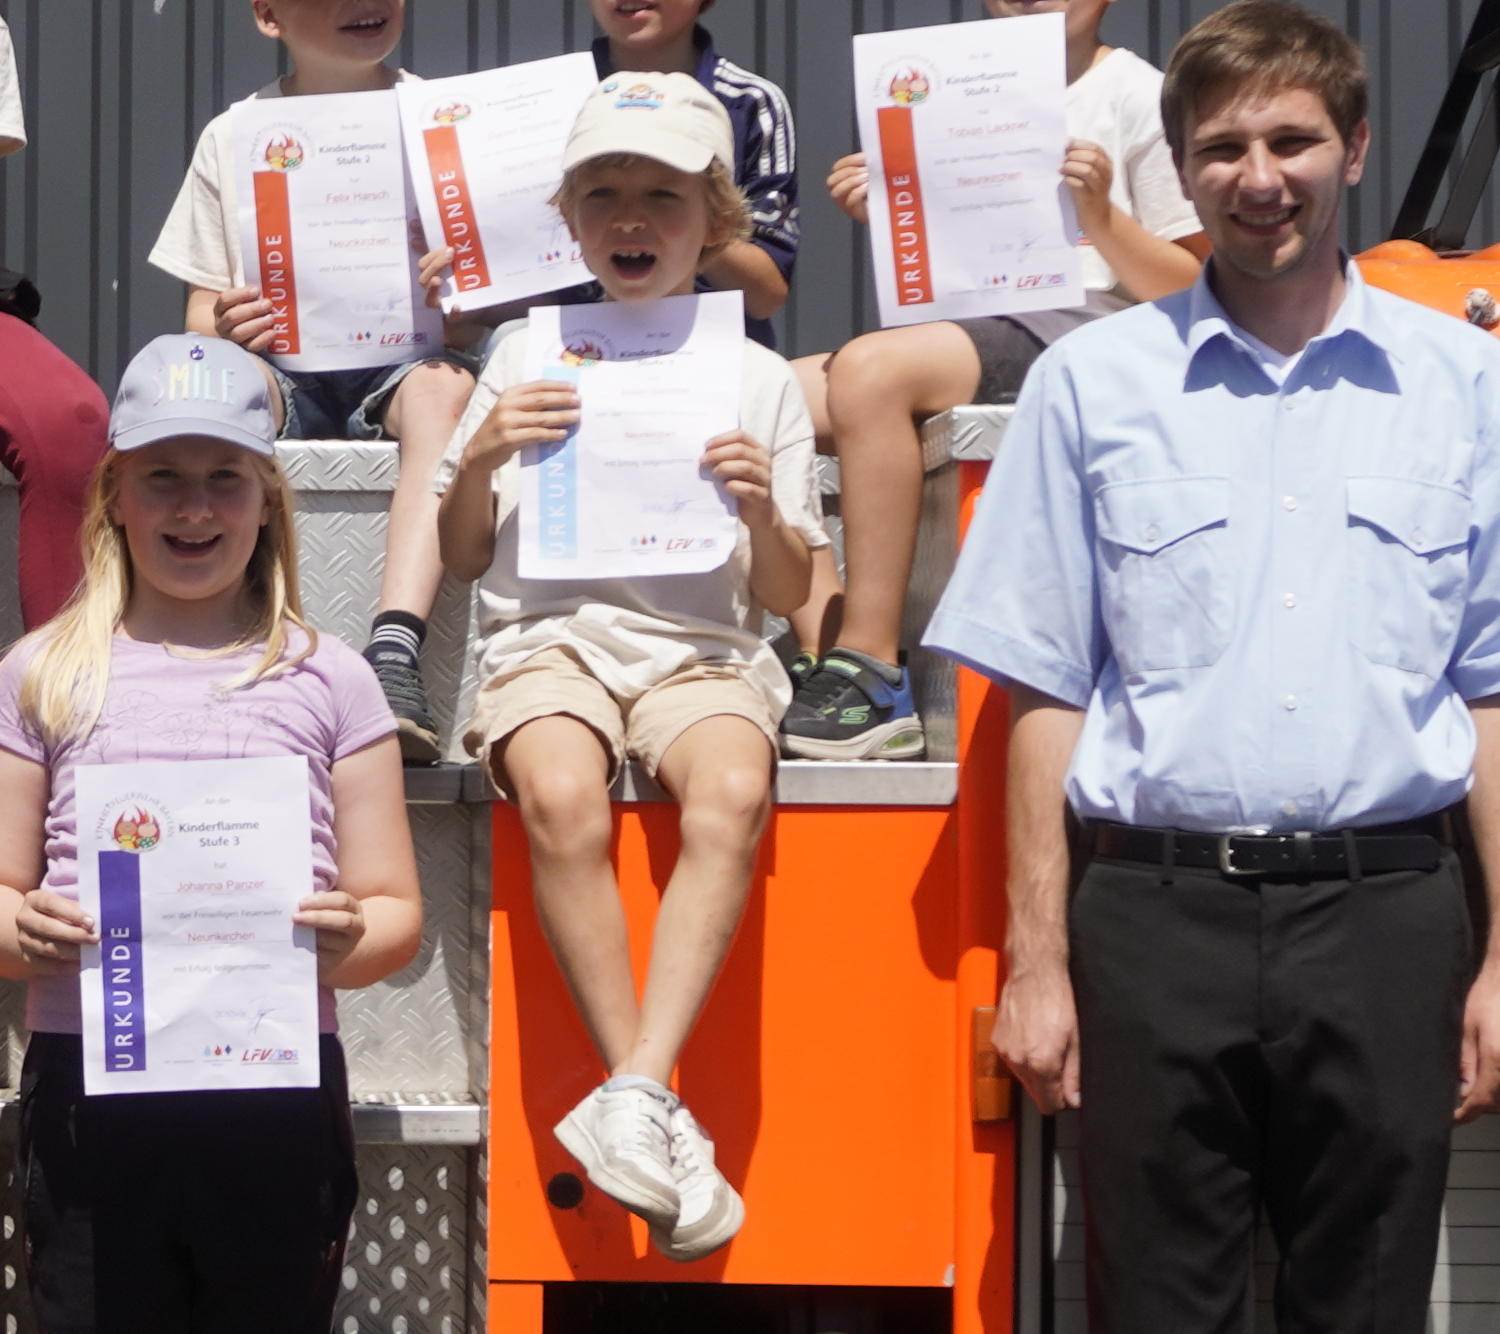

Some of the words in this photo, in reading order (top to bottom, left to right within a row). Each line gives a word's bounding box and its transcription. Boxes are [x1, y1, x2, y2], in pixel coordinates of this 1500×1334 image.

[319, 143, 387, 154] Kinderflamme
[336, 156, 361, 165] Stufe
[365, 155, 371, 163] 2
[326, 192, 350, 203] Felix
[439, 169, 479, 289] URKUNDE
[329, 236, 391, 248] Neunkirchen
[892, 173, 924, 302] URKUNDE
[265, 234, 291, 353] URKUNDE
[152, 363, 235, 405] SMILE
[179, 821, 260, 833] Kinderflamme
[199, 836, 230, 847] Stufe
[233, 836, 240, 846] 3
[176, 881, 223, 893] Johanna
[226, 879, 266, 891] Panzer
[187, 931, 256, 943] Neunkirchen
[110, 926, 134, 1069] URKUNDE
[241, 1048, 273, 1062] LFV
